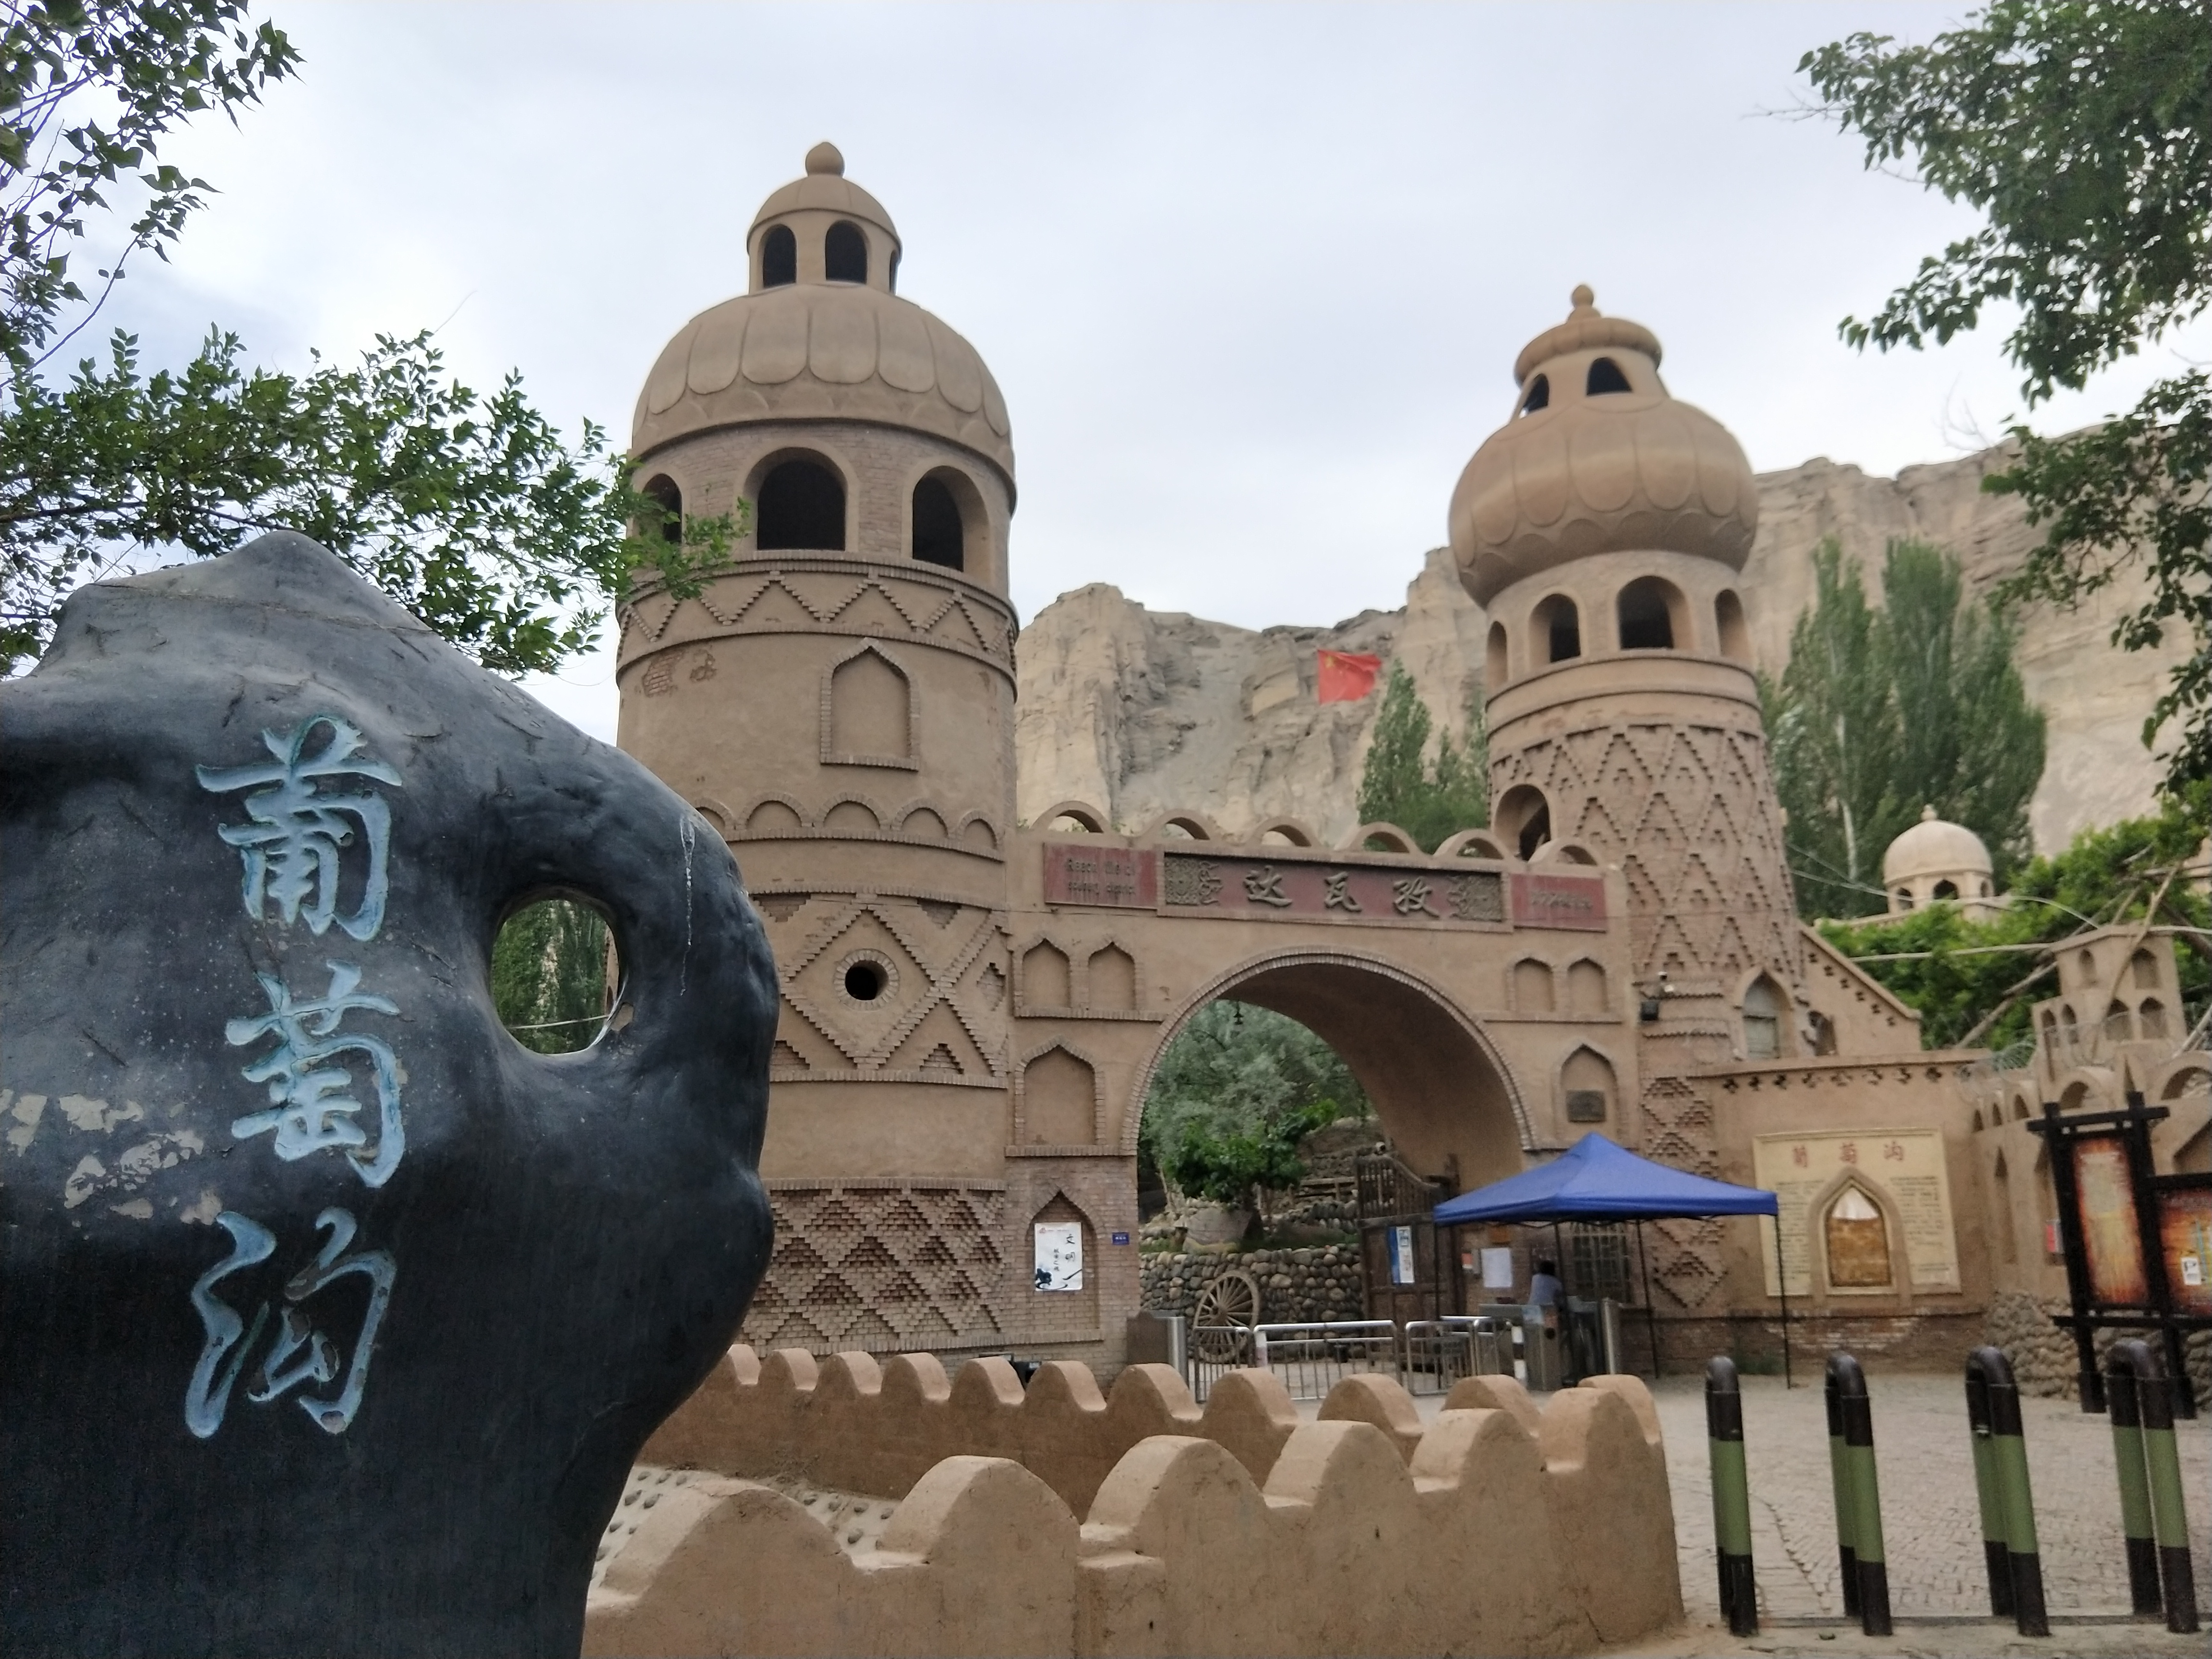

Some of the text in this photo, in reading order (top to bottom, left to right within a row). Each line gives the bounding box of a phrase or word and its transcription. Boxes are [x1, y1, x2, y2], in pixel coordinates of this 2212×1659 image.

[183, 713, 406, 1438] 葡萄沟
[1243, 865, 1440, 918] 达瓦孜
